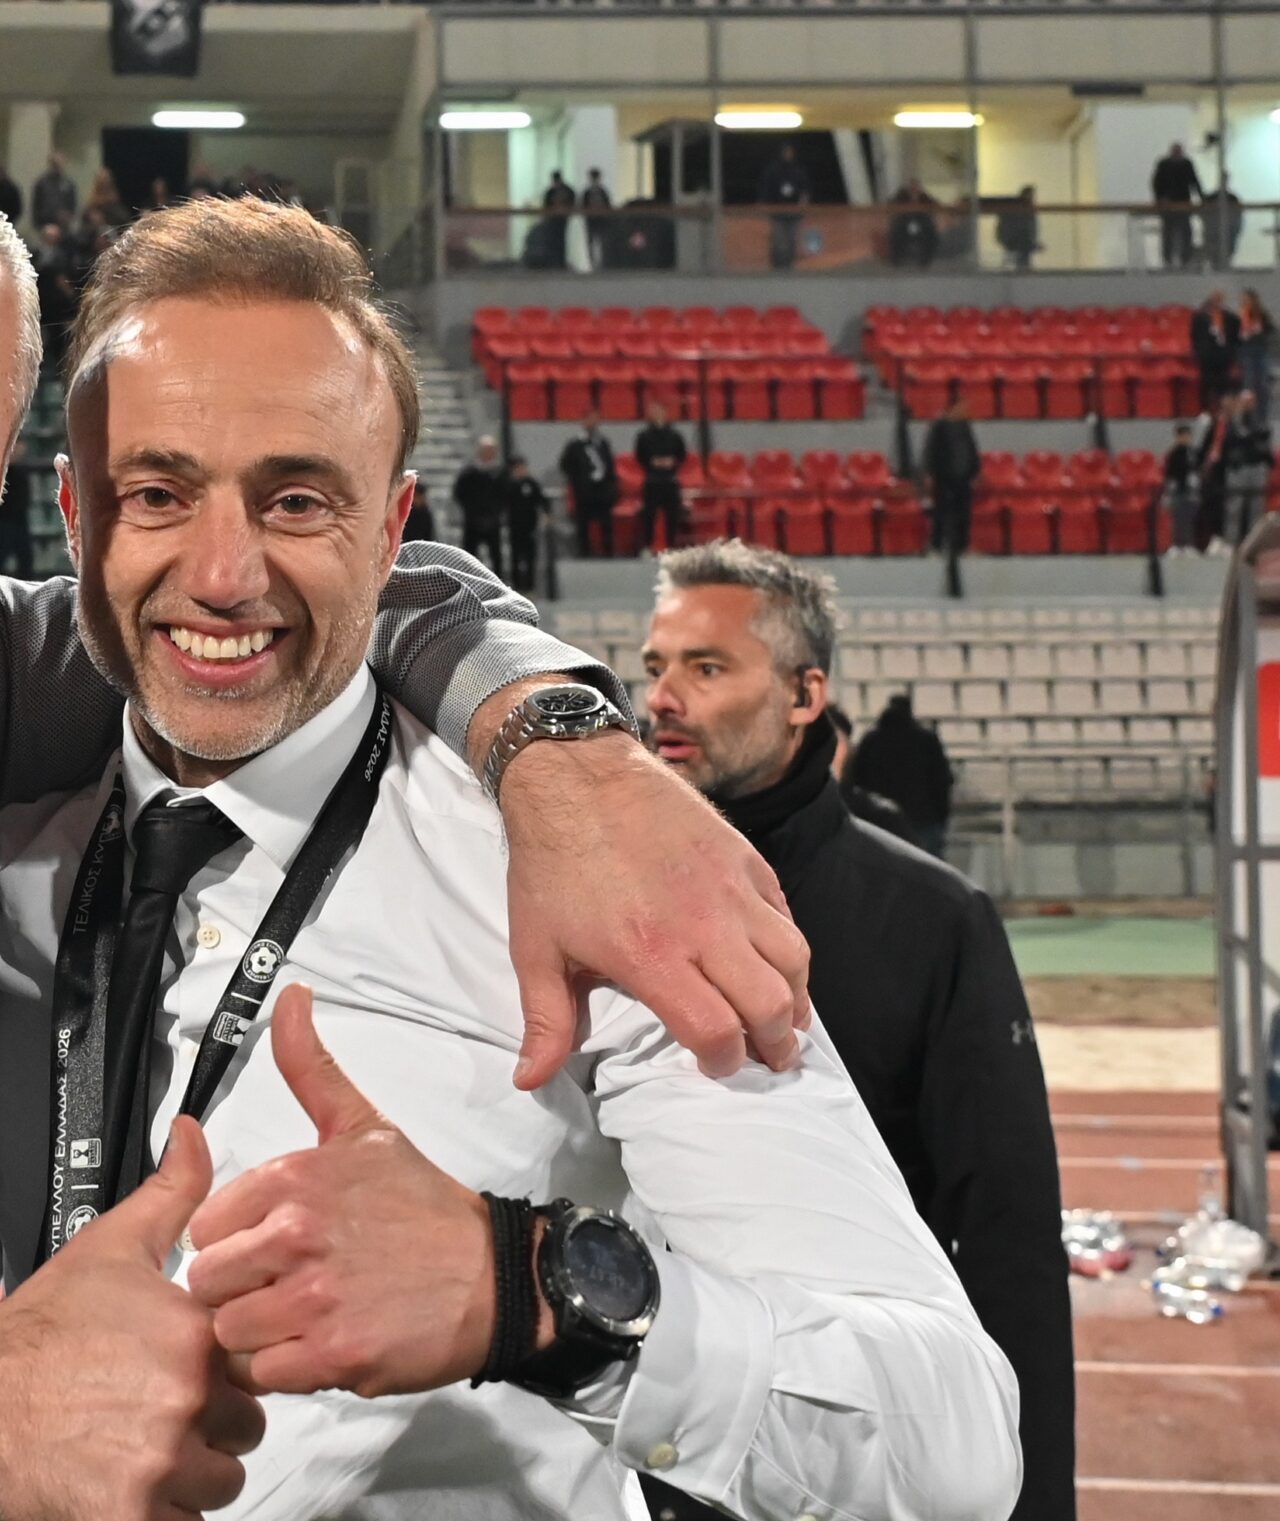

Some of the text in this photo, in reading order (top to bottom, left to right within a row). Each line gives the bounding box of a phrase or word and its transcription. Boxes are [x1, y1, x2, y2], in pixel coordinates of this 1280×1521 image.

[364, 744, 381, 782] 2026
[73, 867, 102, 935] ΤΕΛΙΚΟΣ
[51, 1028, 71, 1256] ΥΠΕΛΛΟΥ ΕΛΛΑΔΑΣ 2026
